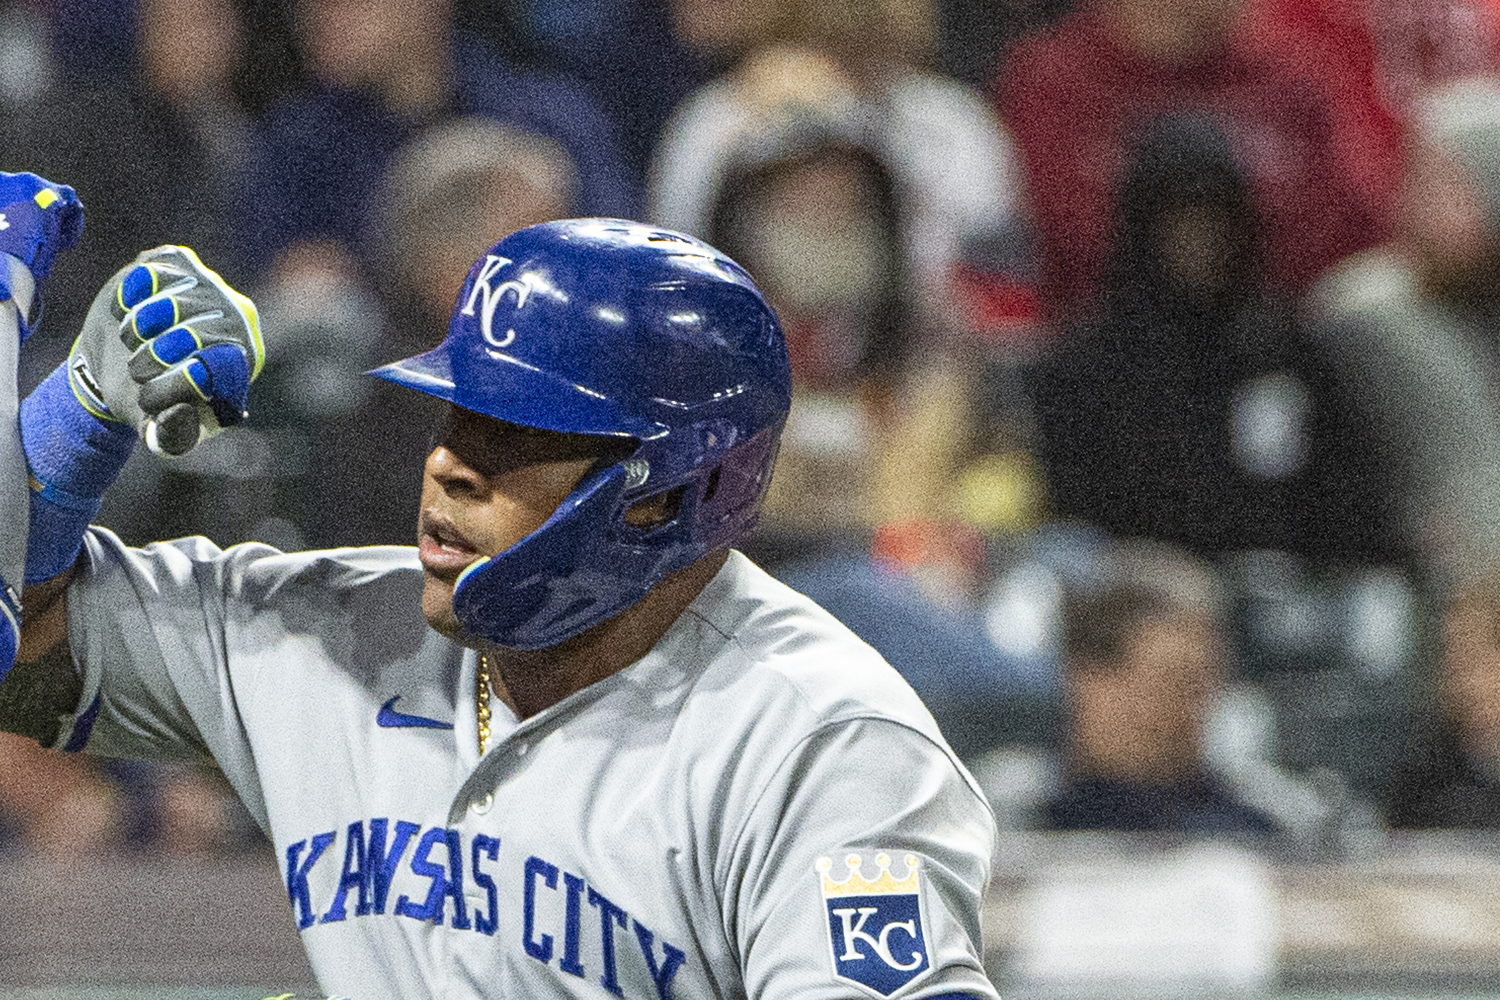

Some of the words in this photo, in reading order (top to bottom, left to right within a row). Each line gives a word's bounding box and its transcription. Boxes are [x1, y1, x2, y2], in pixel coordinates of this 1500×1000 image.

[461, 254, 532, 347] KC
[286, 817, 501, 937] KANSAS
[832, 907, 924, 971] KC
